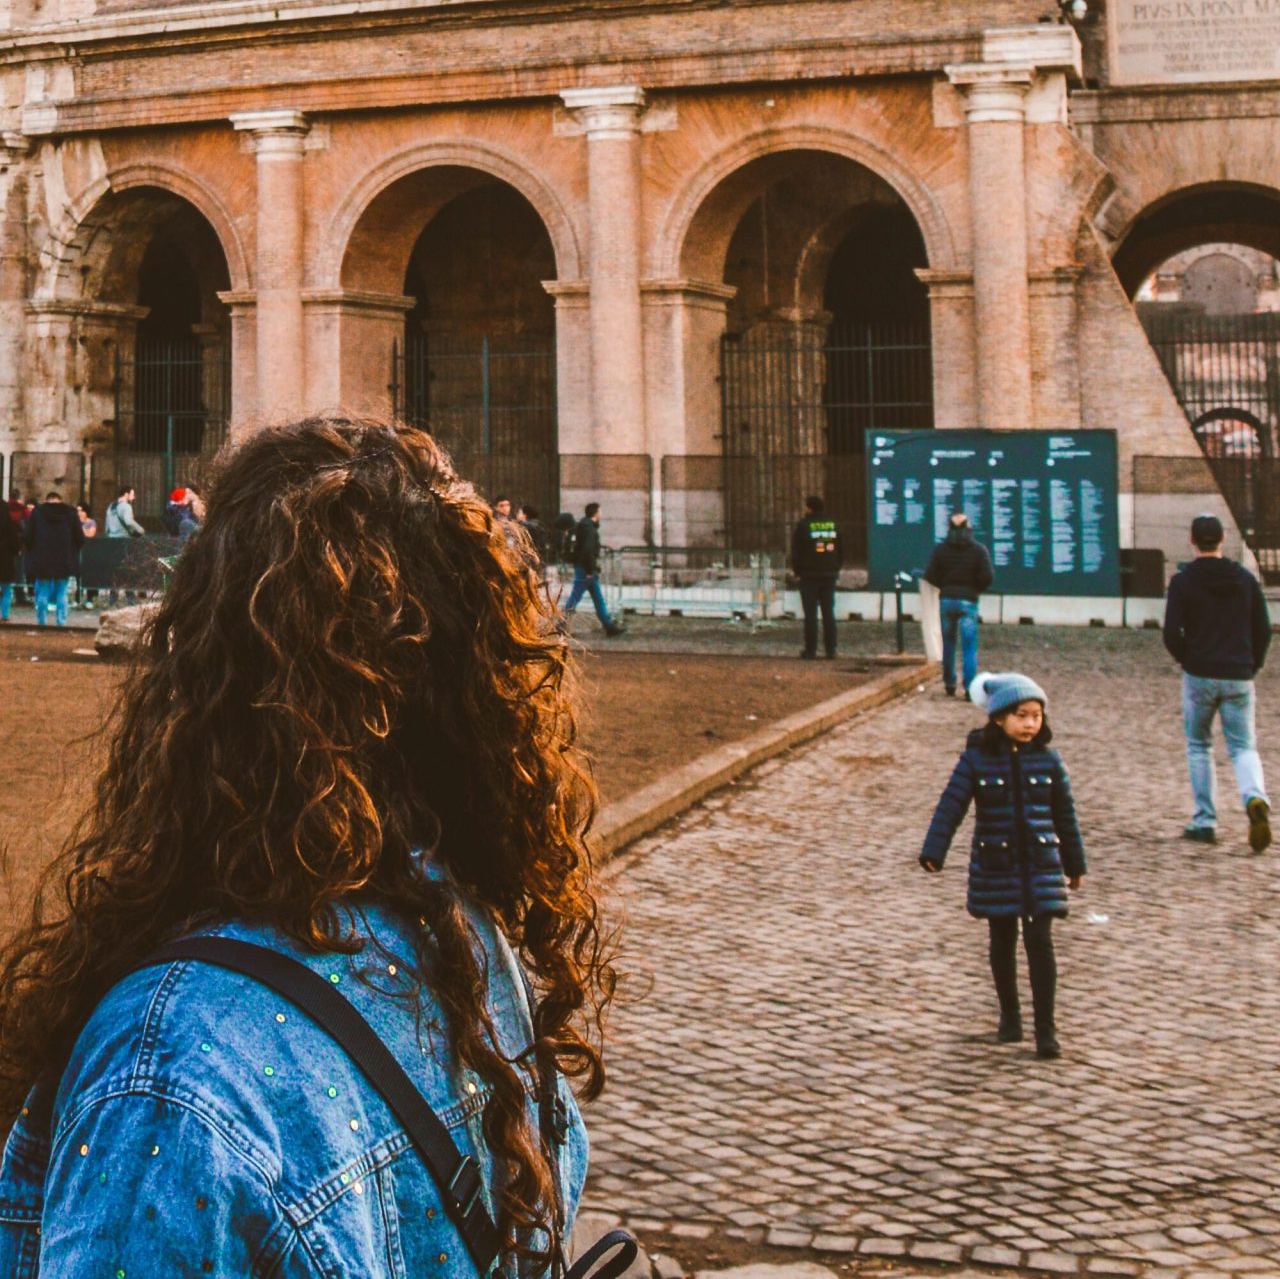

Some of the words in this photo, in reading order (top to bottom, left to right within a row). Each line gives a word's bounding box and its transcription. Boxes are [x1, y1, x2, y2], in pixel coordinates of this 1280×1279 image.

[1133, 3, 1172, 19] PIVS
[1177, 2, 1196, 18] IX
[1202, 0, 1247, 16] PONT
